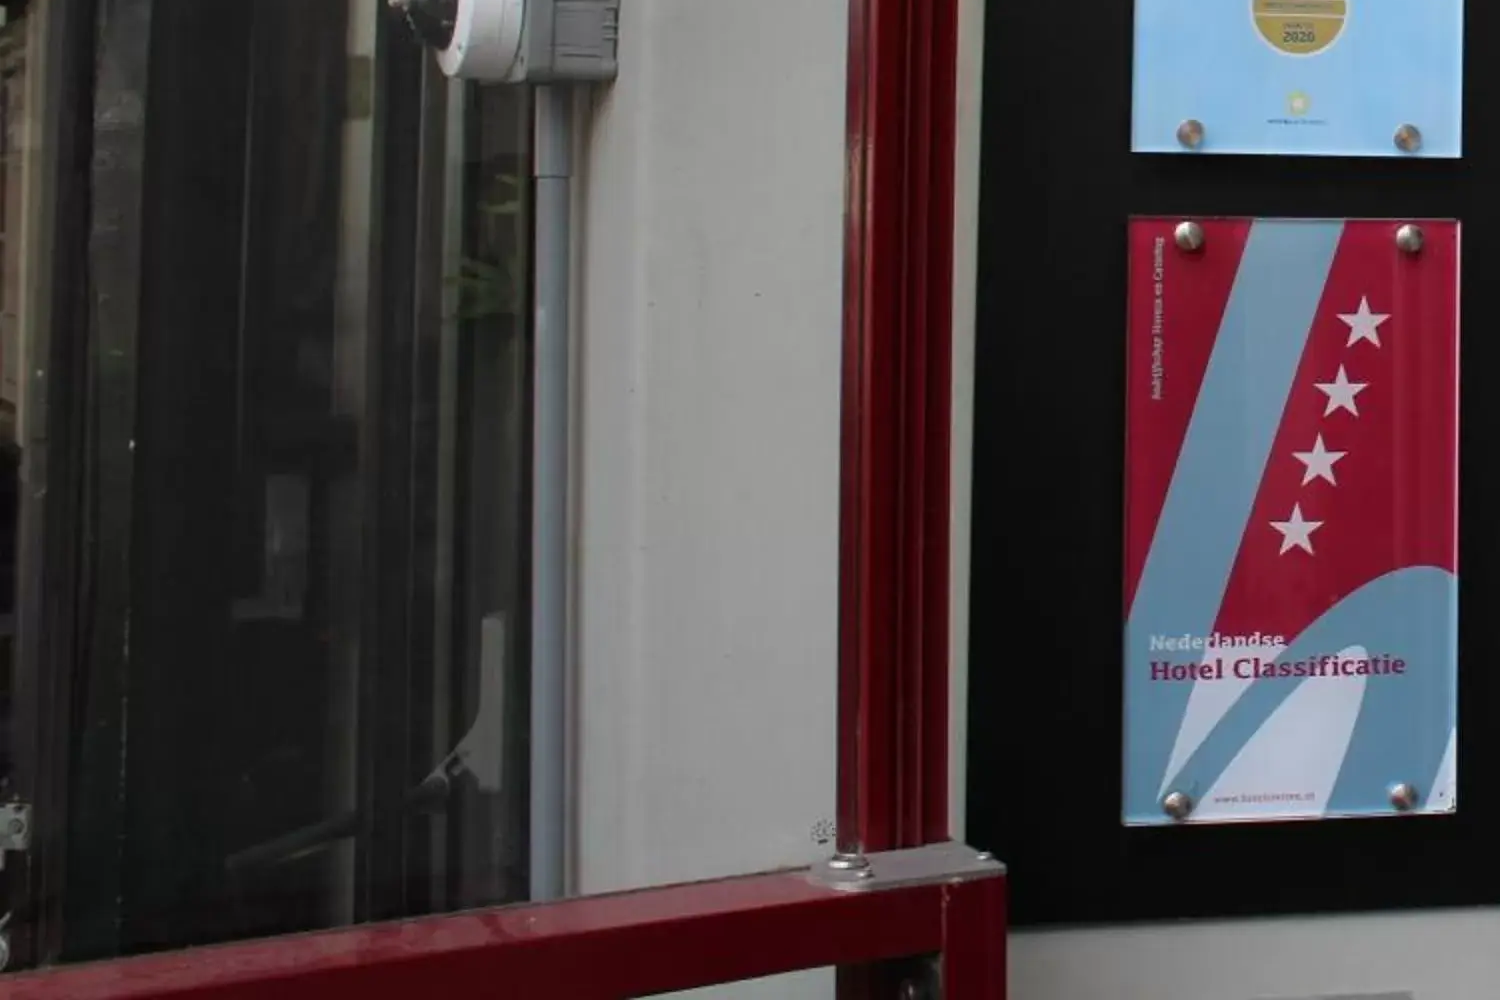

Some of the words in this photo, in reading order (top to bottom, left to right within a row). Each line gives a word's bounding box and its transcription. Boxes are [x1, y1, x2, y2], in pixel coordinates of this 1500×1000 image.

[1283, 31, 1315, 43] 2020
[1151, 632, 1287, 651] Nederlandse
[1150, 658, 1223, 681] Hotel
[1233, 654, 1406, 679] Classificatie
